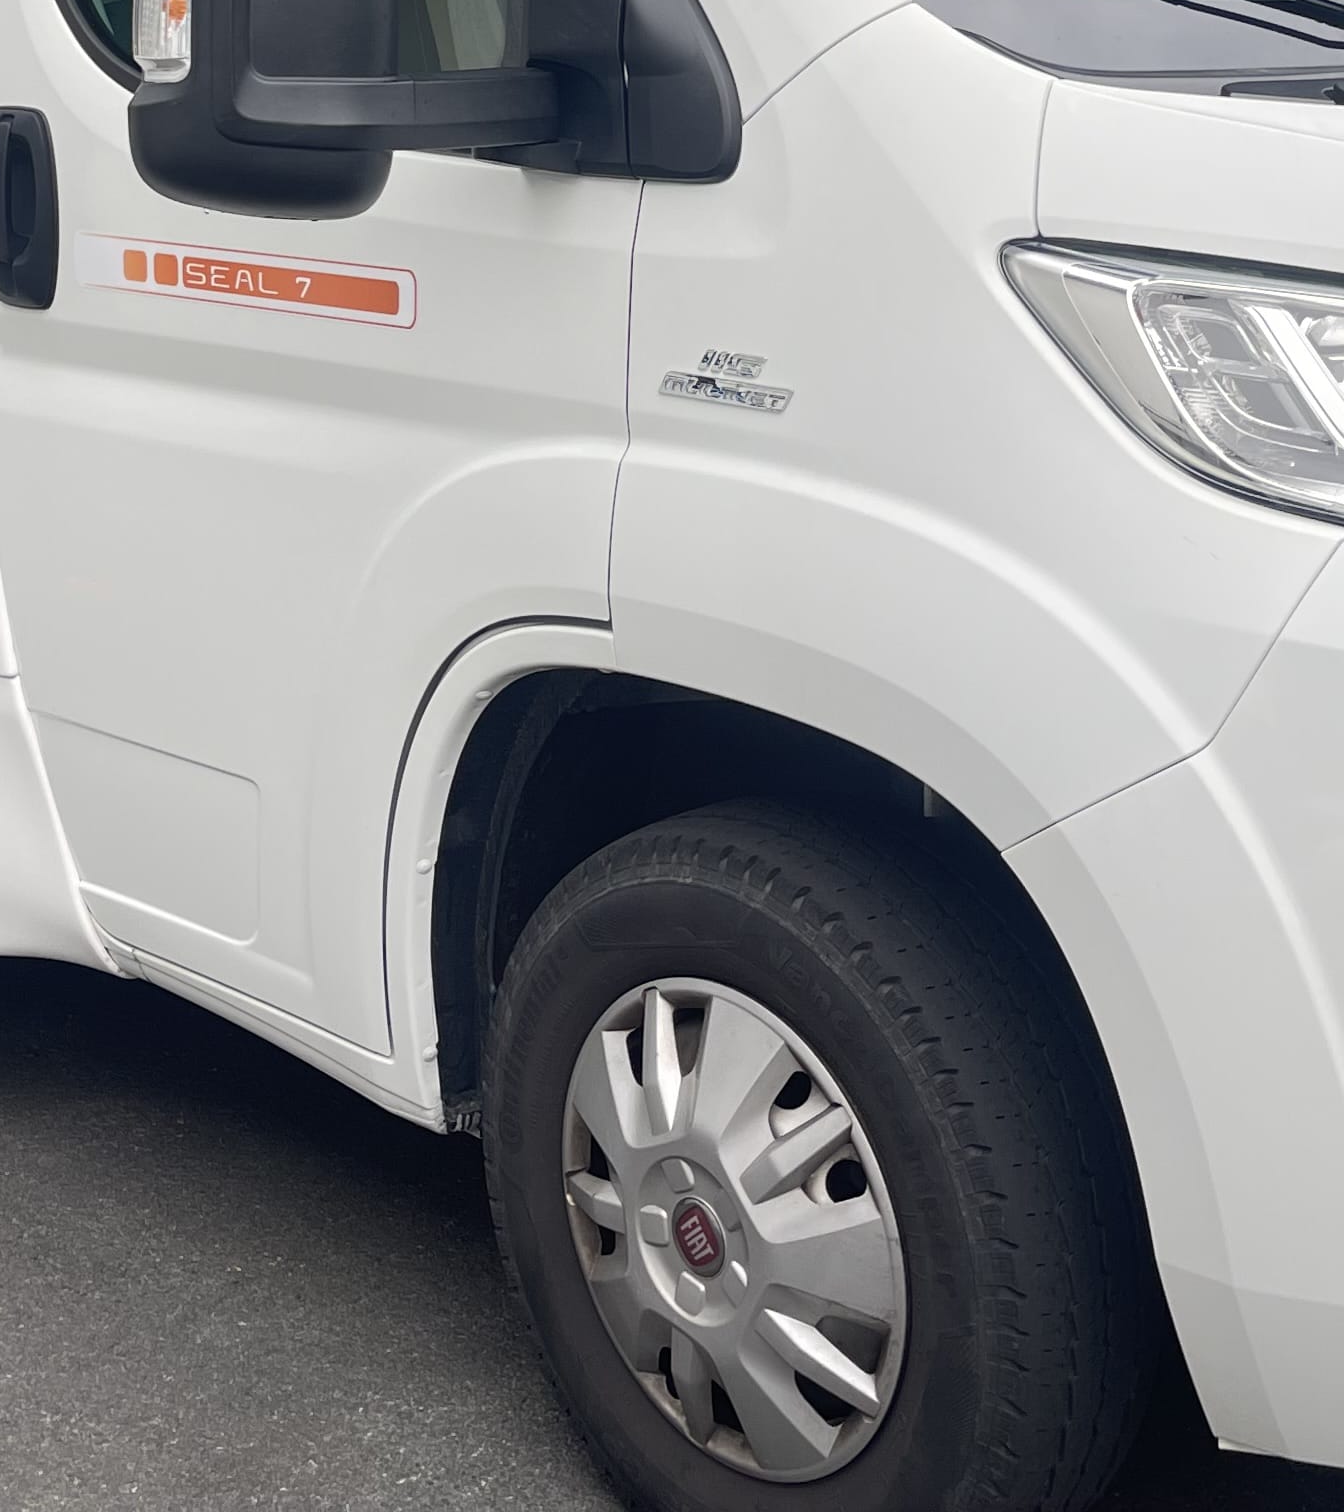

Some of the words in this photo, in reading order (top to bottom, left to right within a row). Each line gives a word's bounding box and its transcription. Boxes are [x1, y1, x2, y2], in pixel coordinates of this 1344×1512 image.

[185, 262, 279, 296] SEAL
[295, 276, 312, 299] 7
[680, 1215, 715, 1261] FIAT
